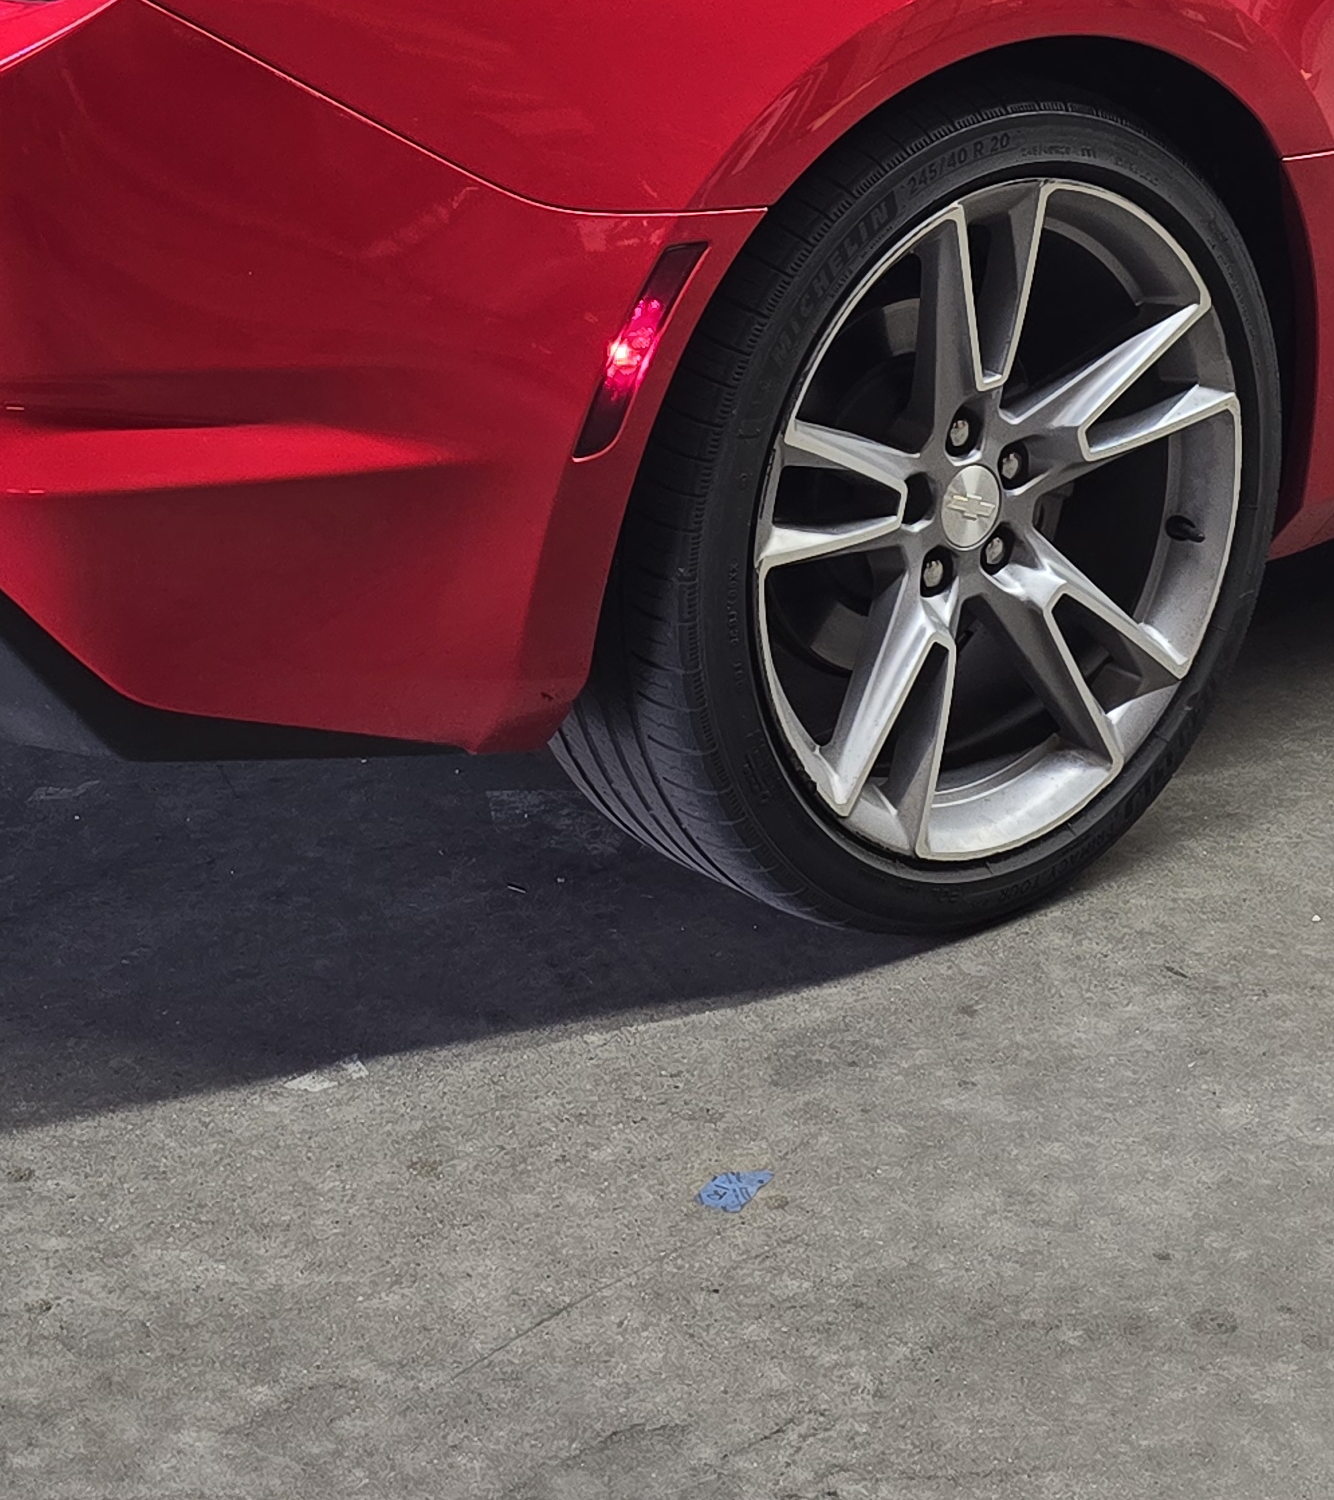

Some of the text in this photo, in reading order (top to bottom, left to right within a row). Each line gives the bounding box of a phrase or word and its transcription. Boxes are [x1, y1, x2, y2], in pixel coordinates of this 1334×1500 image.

[907, 147, 968, 196] 245/40
[972, 140, 985, 158] R
[989, 132, 1011, 153] 20
[769, 198, 892, 368] MICHELIN
